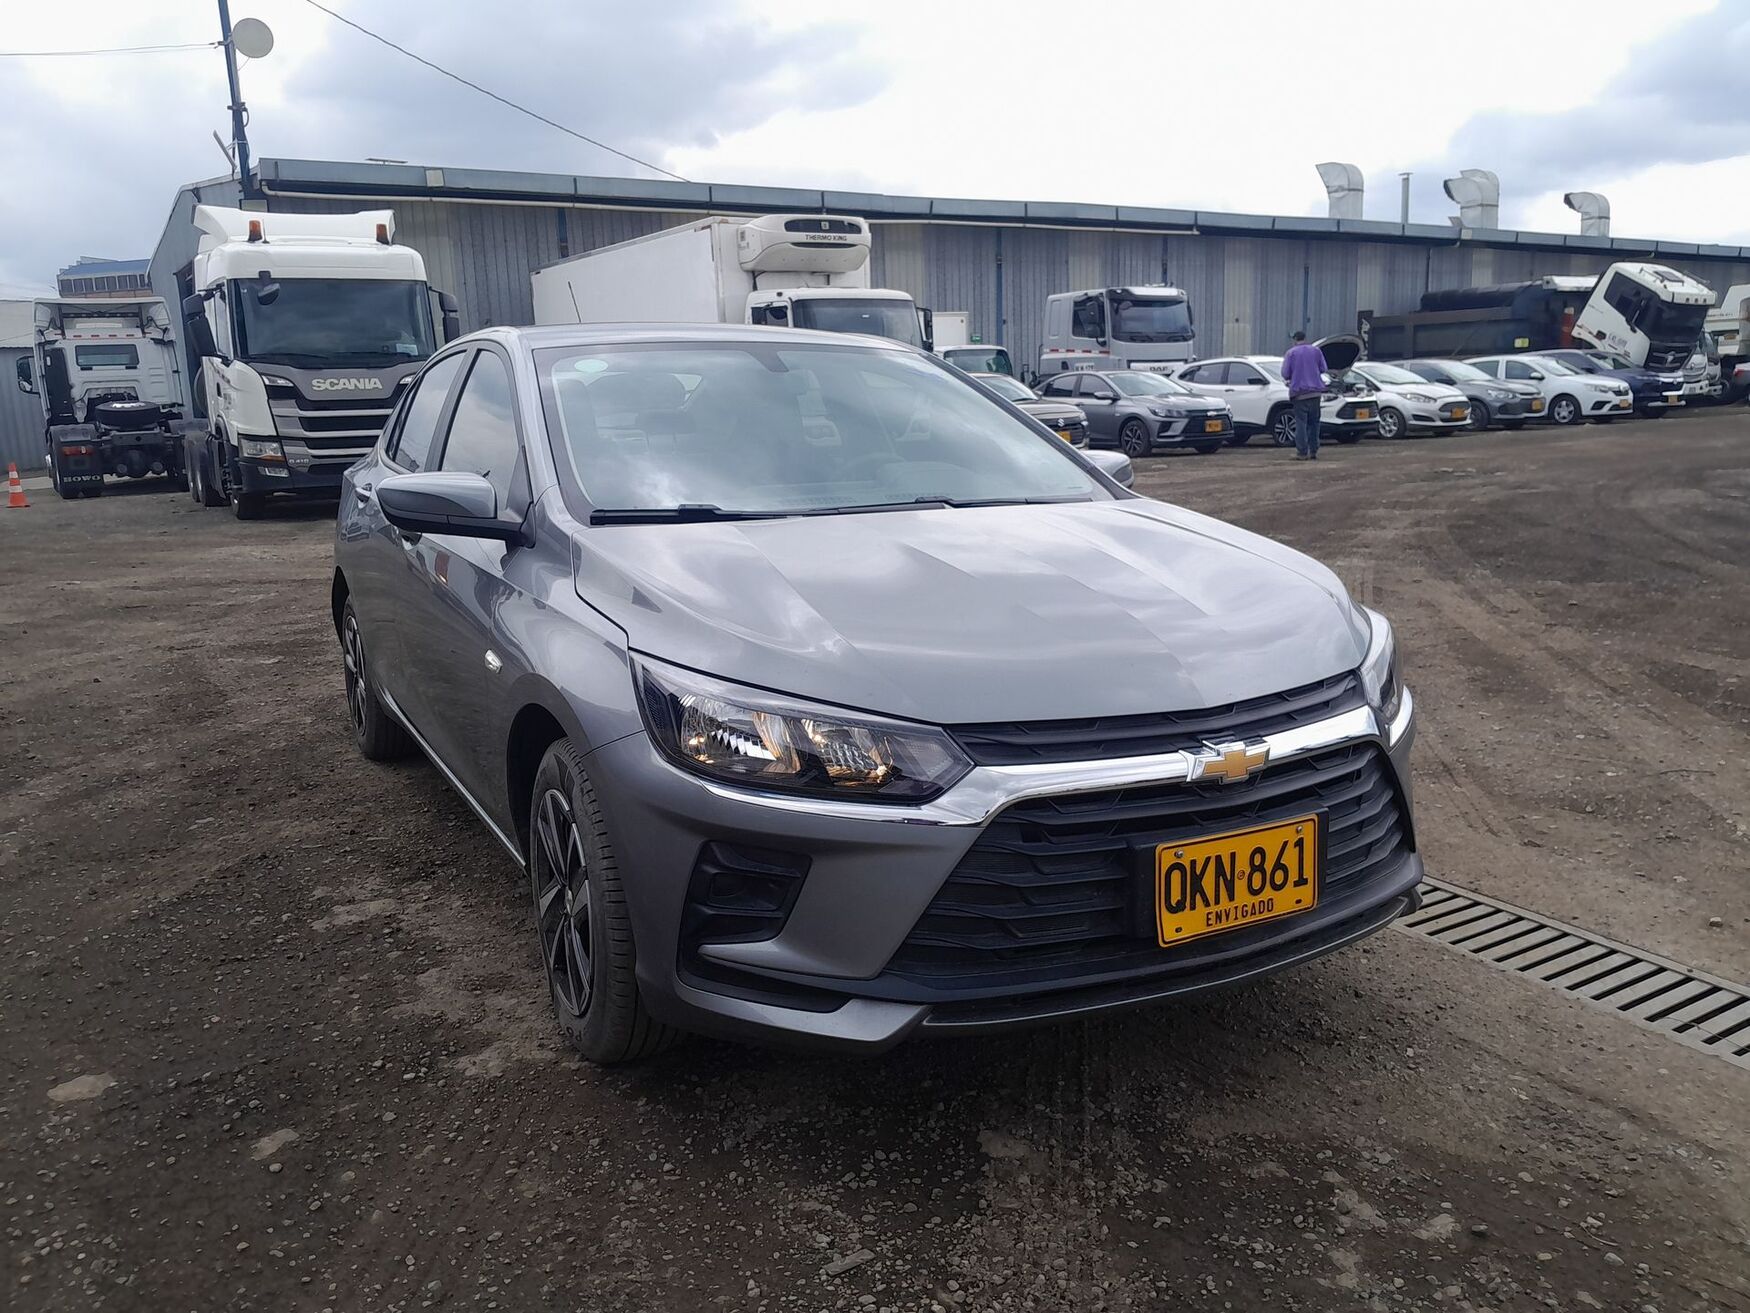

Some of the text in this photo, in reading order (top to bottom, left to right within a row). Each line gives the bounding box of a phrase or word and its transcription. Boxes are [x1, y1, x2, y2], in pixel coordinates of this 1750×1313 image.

[311, 378, 383, 391] SCANIA
[1164, 837, 1309, 915] QKN 861
[1206, 898, 1274, 927] ENVIGADO
